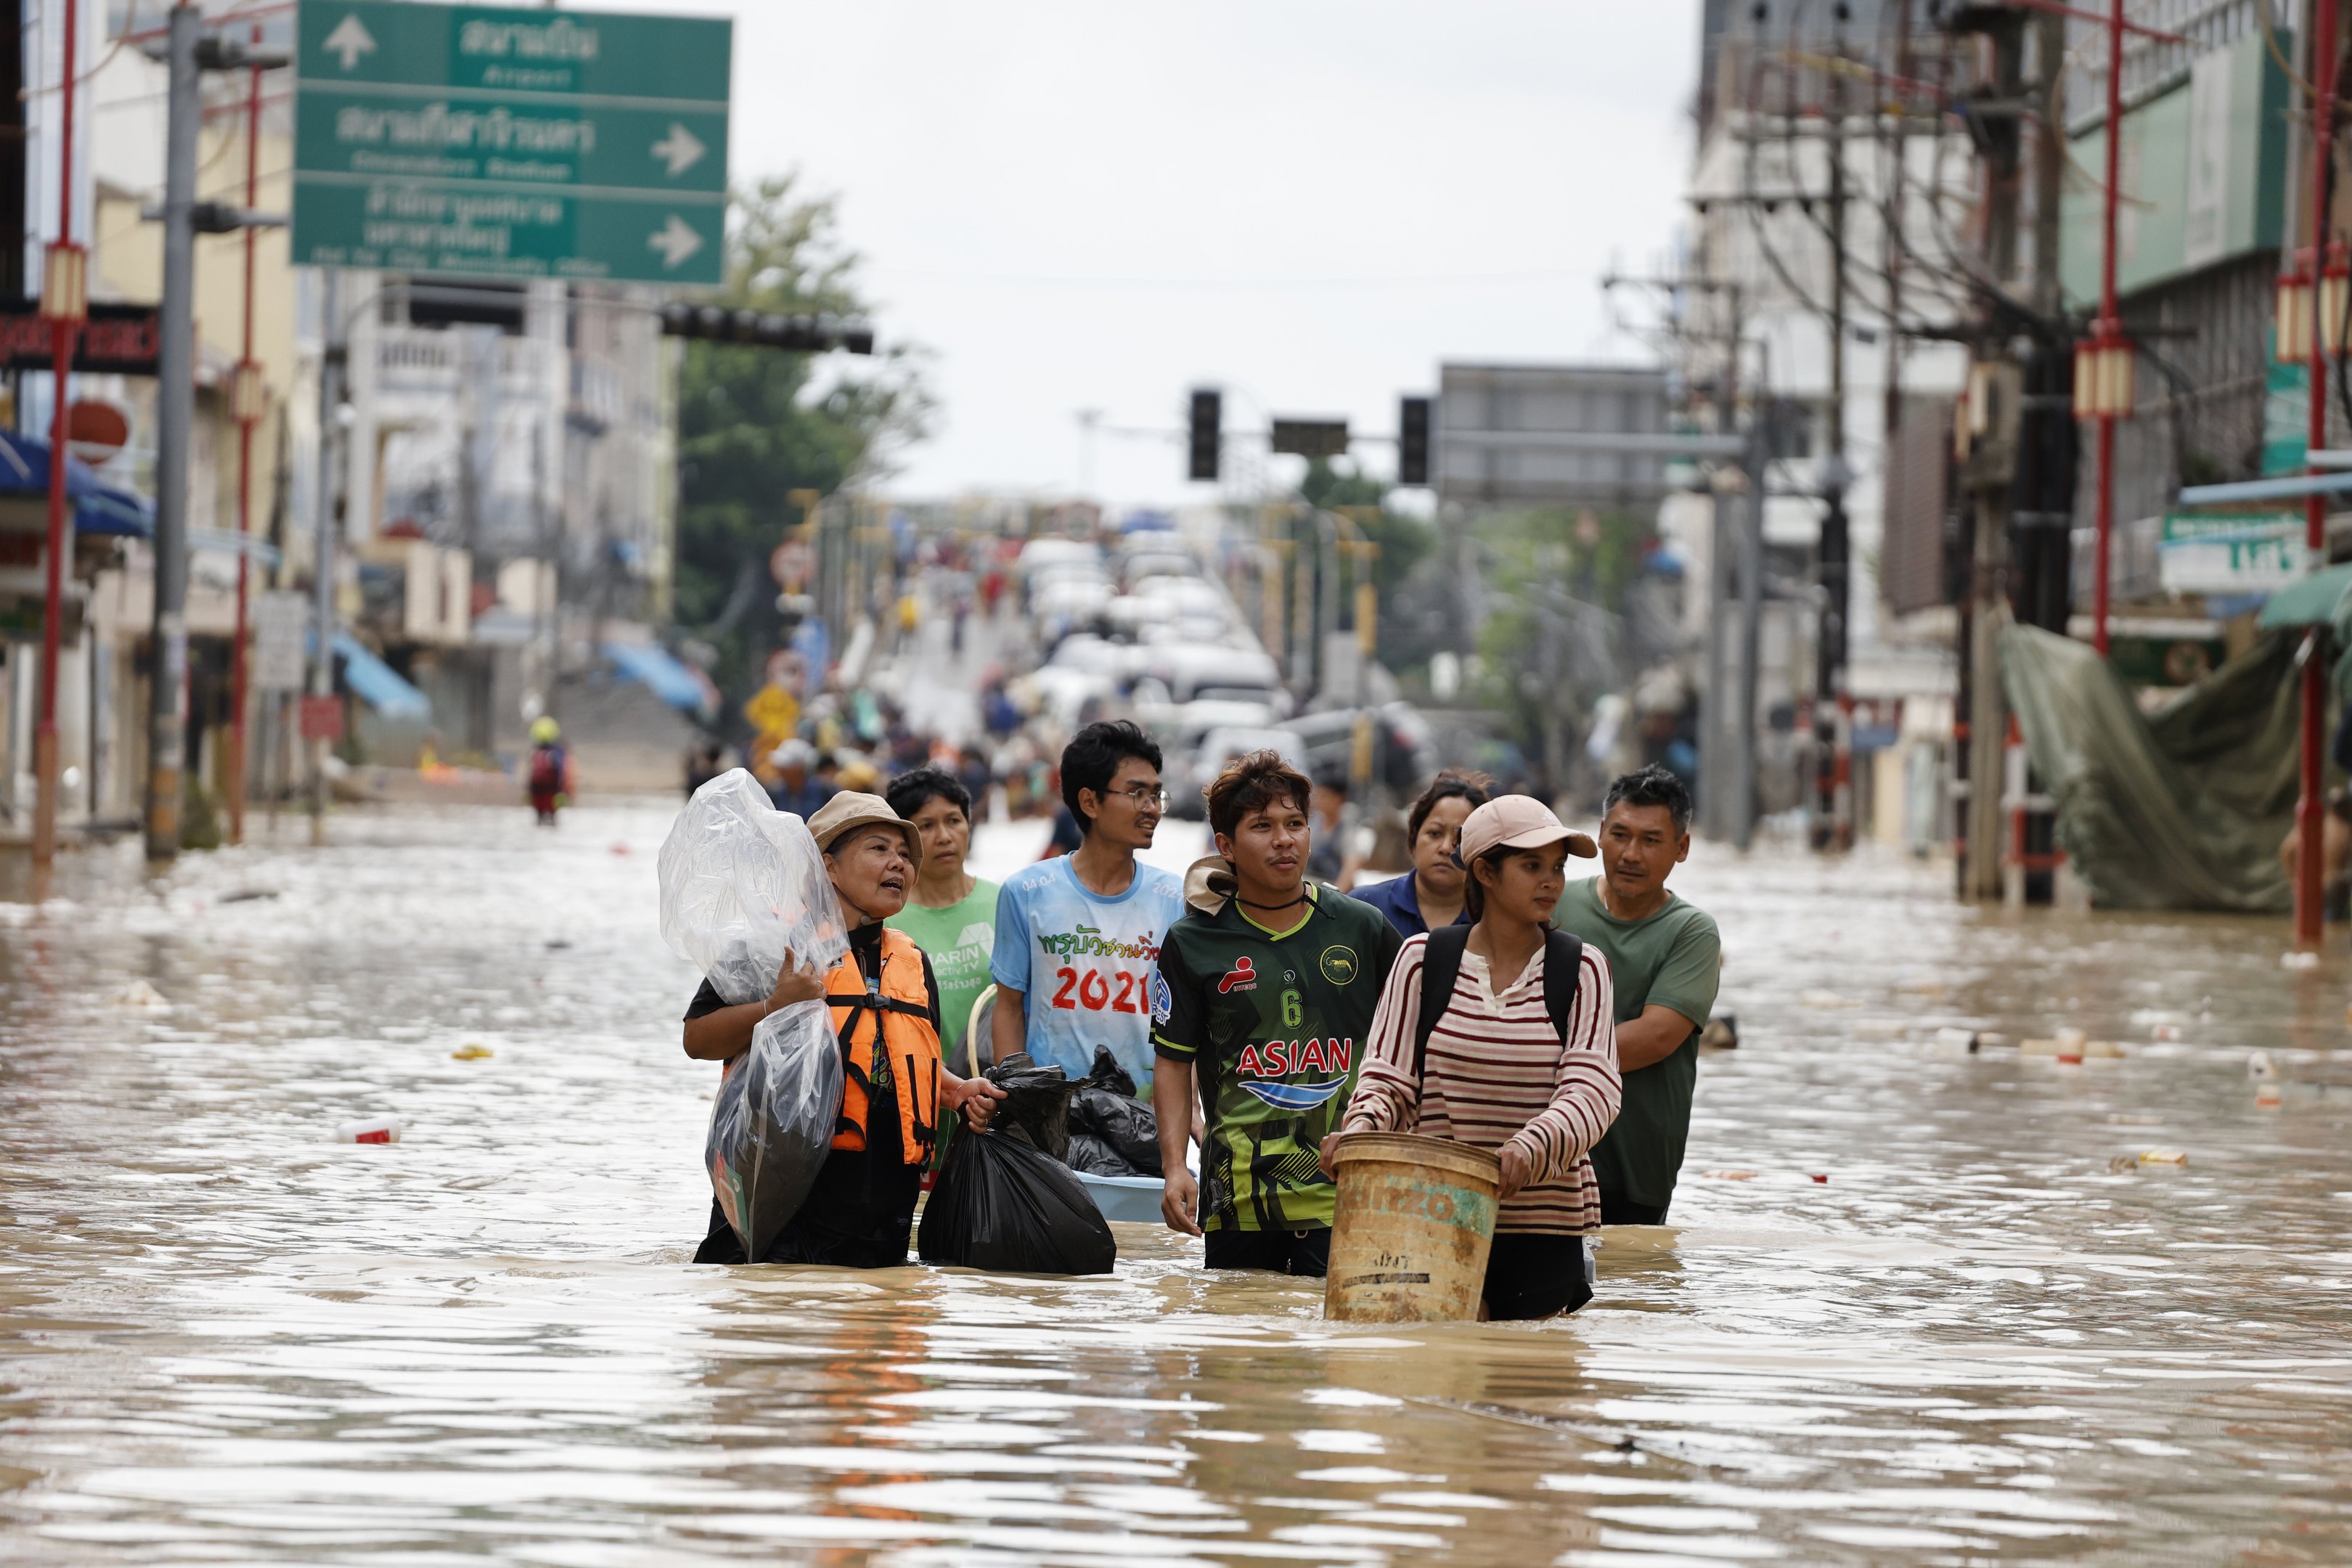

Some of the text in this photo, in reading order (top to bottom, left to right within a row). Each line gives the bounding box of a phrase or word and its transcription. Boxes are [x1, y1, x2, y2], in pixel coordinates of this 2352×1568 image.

[1022, 873, 1055, 891] 04.04
[1052, 967, 1149, 1014] 2021
[1281, 989, 1303, 1029] 6
[1236, 1037, 1352, 1077] ASIAN
